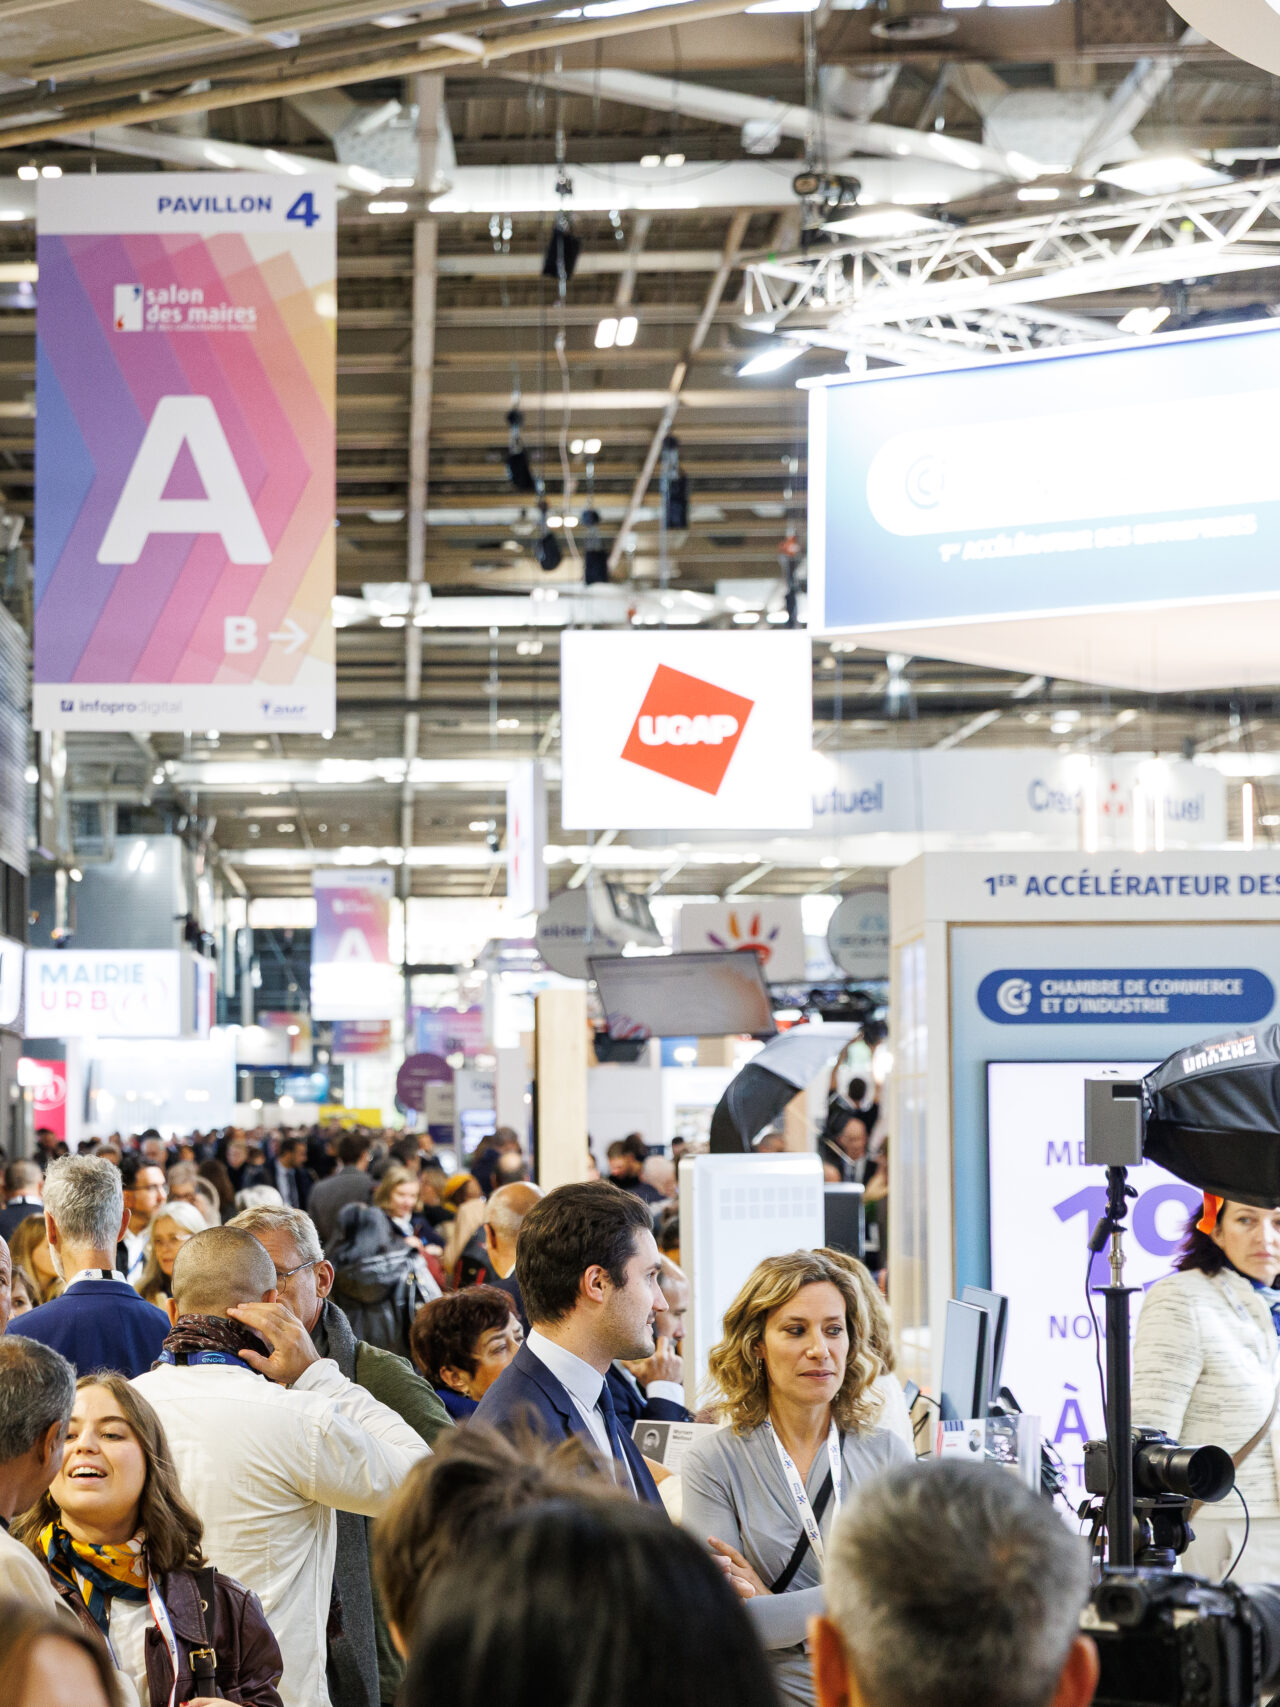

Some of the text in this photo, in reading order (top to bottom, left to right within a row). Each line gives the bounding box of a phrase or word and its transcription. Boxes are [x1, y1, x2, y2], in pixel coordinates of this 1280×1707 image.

[157, 191, 321, 228] PAVILLON 4
[145, 284, 204, 304] salon
[145, 304, 257, 323] des maires
[96, 395, 274, 566] A
[224, 616, 258, 653] B
[639, 714, 739, 746] UGAP
[1025, 868, 1230, 897] ACCÉLÉRATEUR
[40, 963, 145, 985] MAIRIE
[1040, 979, 1121, 996] CHAMBRE
[1124, 979, 1146, 995] DE
[1148, 978, 1244, 996] COMMERCE
[1040, 997, 1169, 1014] ET D'INDUSTRIE
[1183, 1039, 1257, 1075] ZHIYUN
[1054, 1382, 1090, 1443] À
